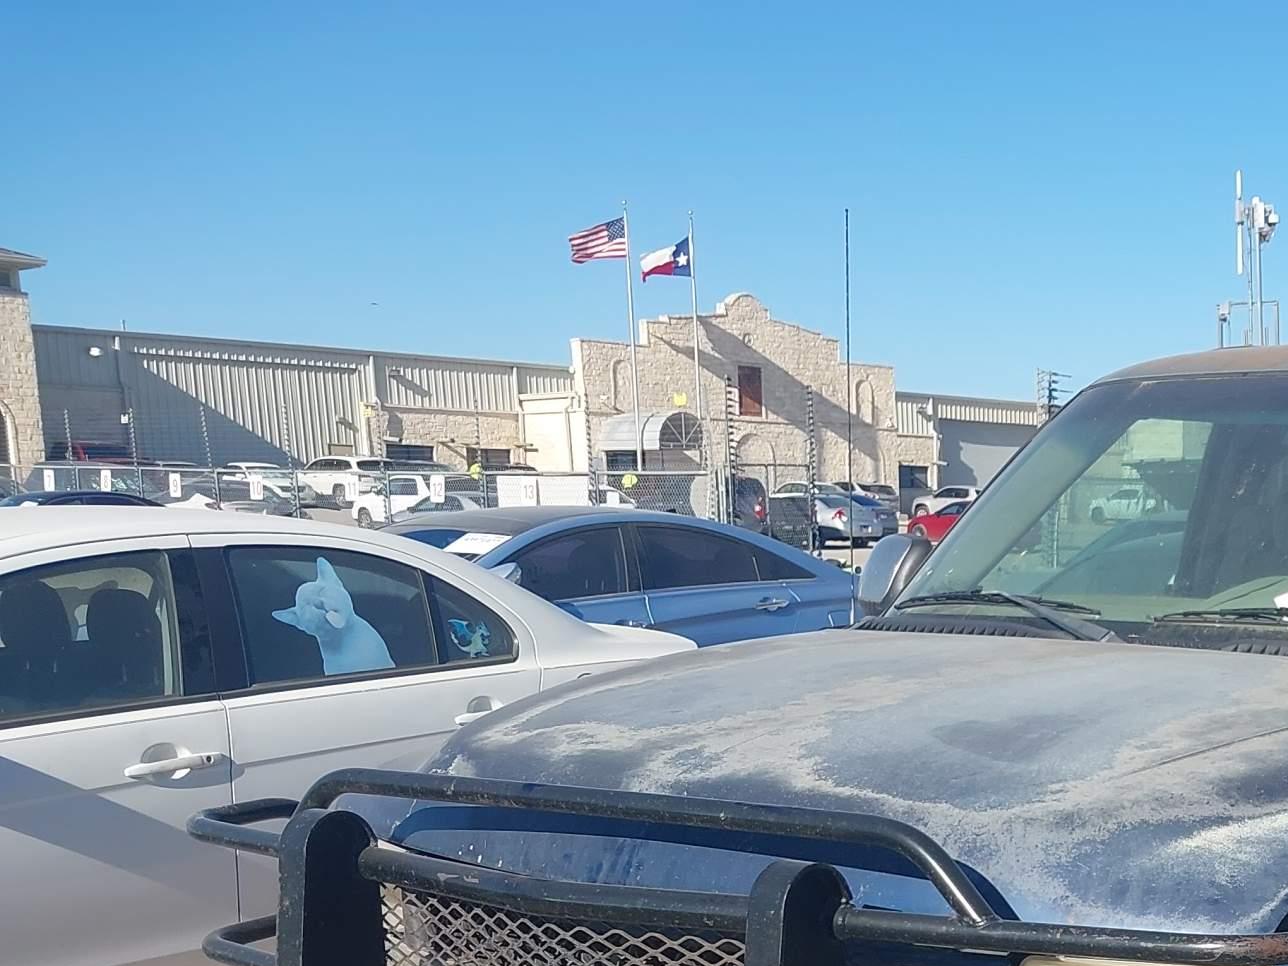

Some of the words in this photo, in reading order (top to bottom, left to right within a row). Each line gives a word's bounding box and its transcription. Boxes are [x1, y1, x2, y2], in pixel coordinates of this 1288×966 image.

[252, 481, 262, 496] 10
[433, 482, 443, 497] 12
[523, 484, 535, 500] 13
